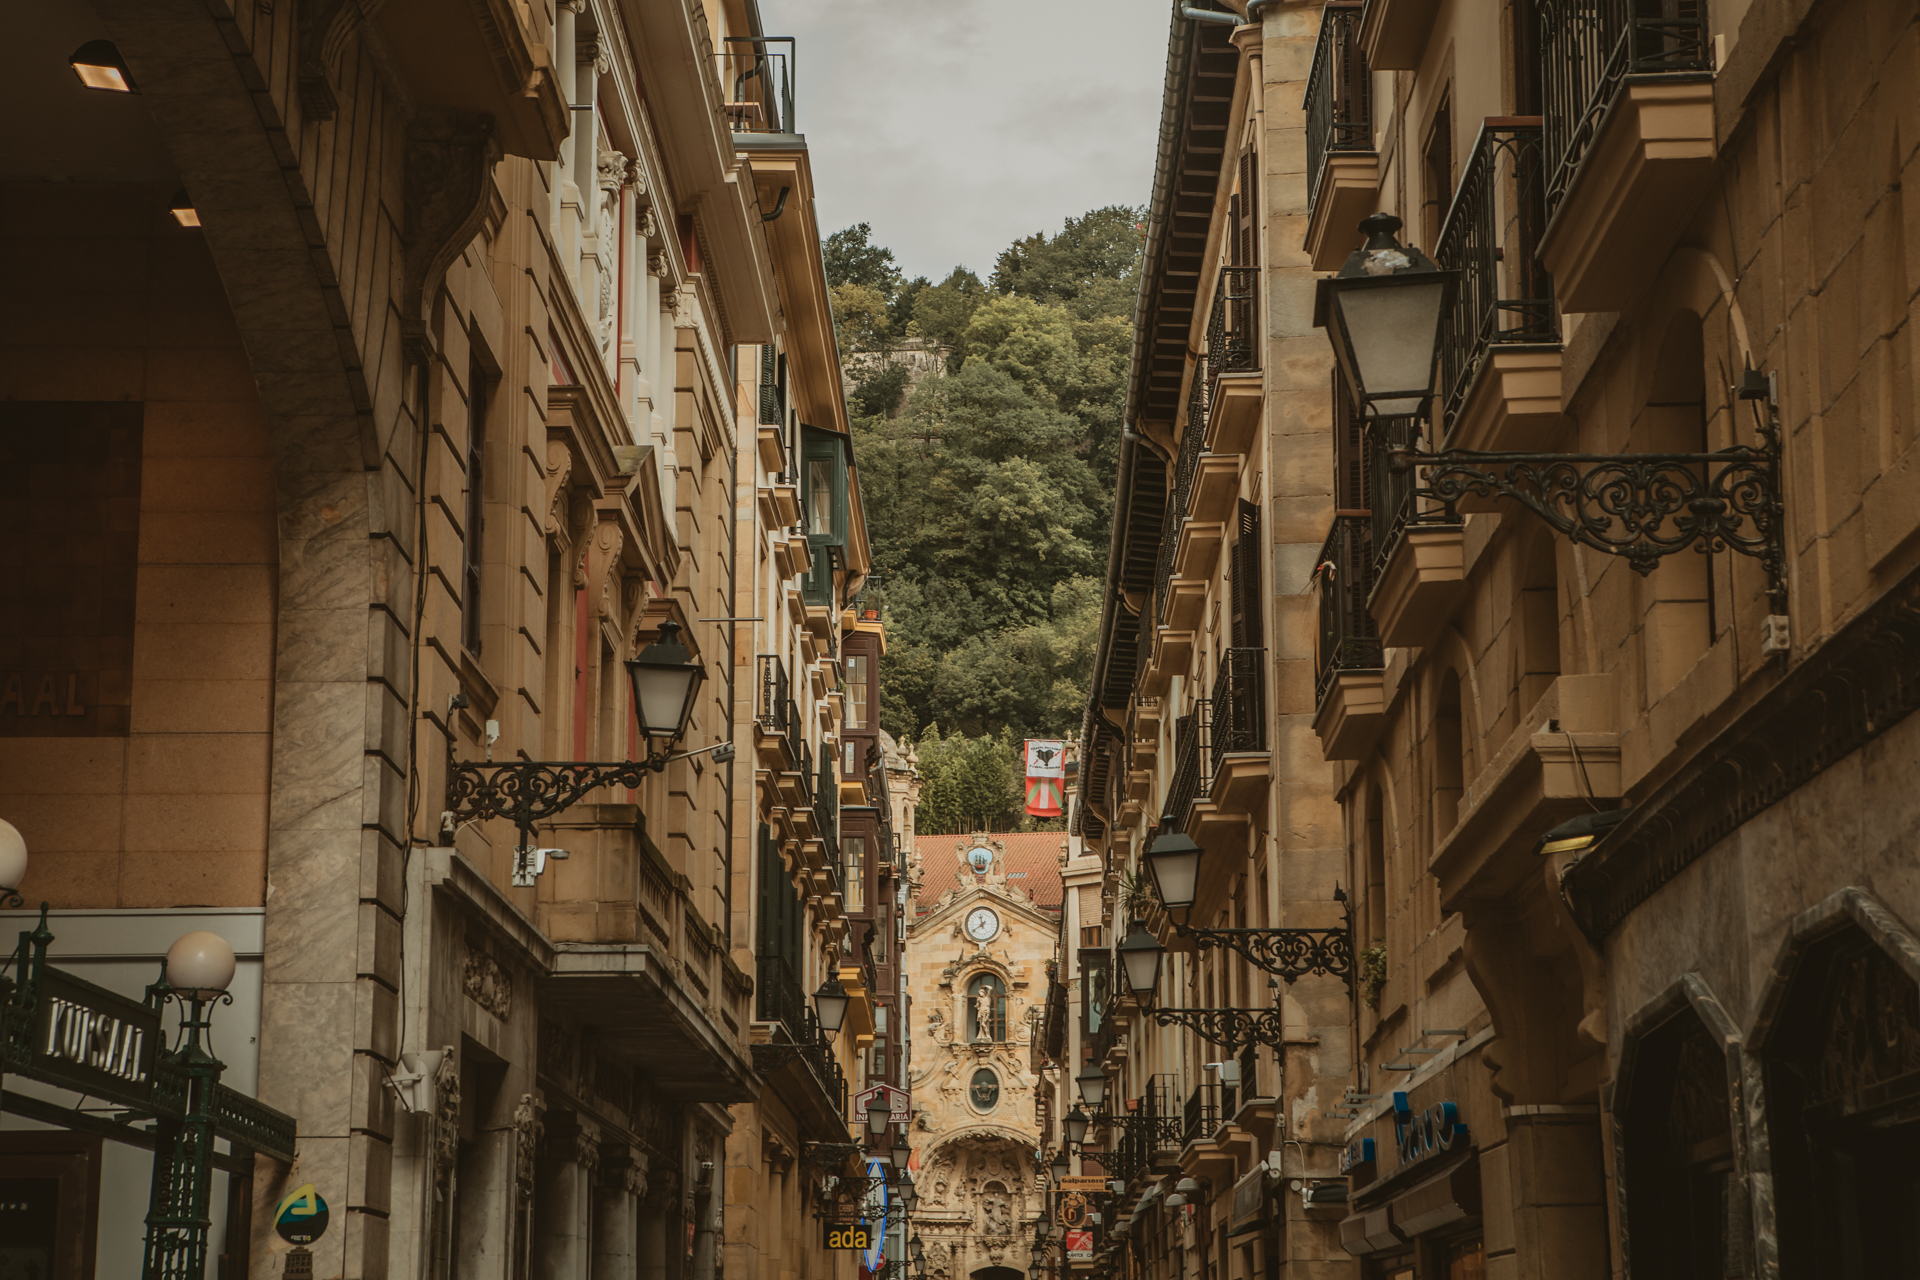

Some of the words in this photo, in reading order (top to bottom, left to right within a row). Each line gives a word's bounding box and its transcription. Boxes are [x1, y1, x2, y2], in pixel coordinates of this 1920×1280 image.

[46, 997, 147, 1082] KURSAAL
[856, 1088, 908, 1113] CB
[856, 1113, 908, 1121] INARIA
[829, 1225, 867, 1248] ada
